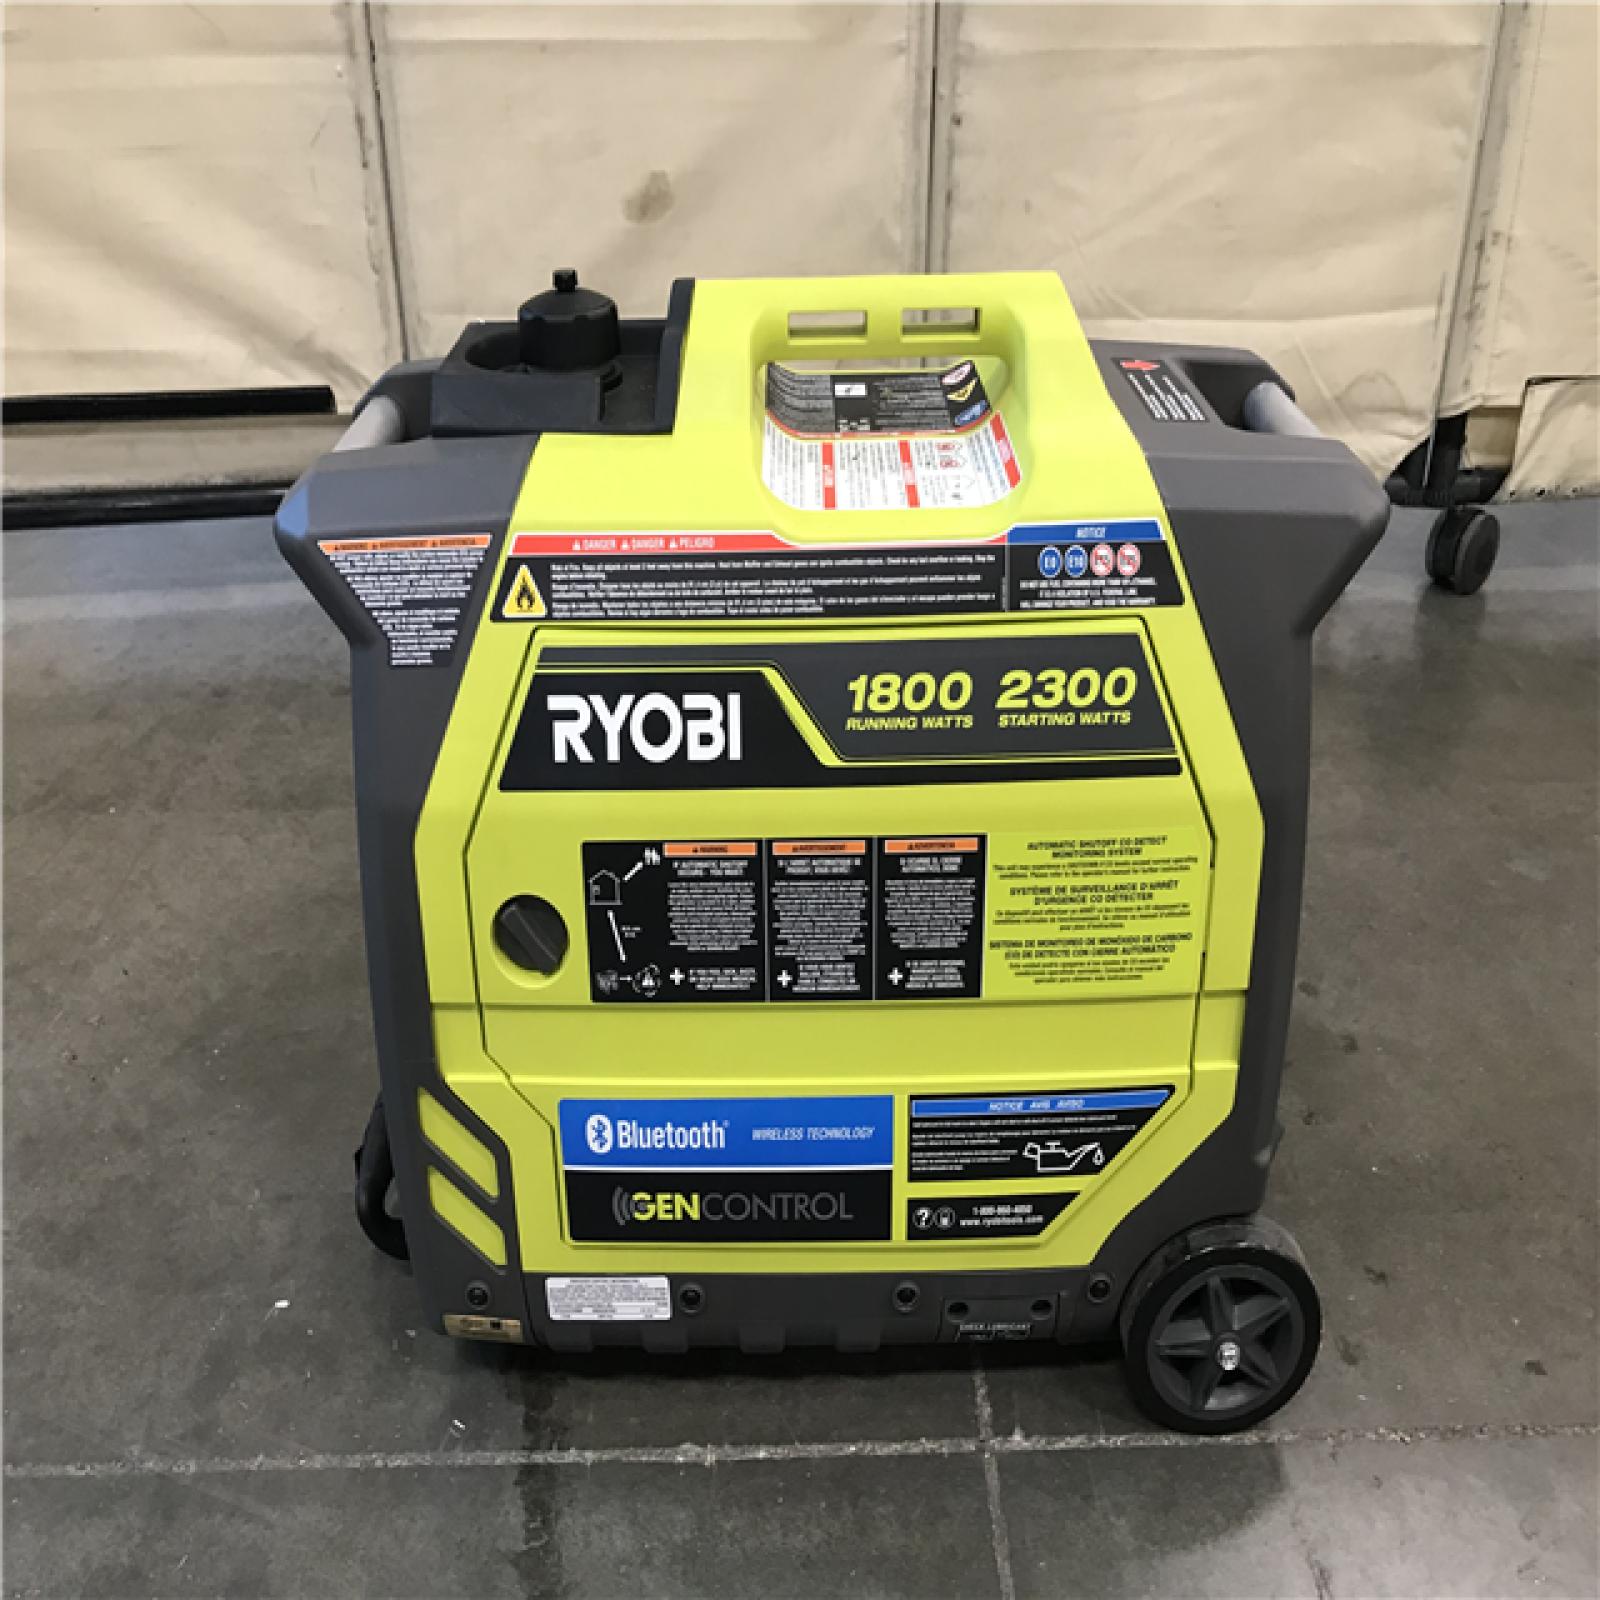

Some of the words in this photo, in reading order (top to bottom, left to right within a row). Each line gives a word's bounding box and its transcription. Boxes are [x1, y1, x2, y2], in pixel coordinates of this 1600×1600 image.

[847, 671, 974, 713] 1800
[994, 667, 1138, 709] 2300
[546, 692, 743, 764] RYOBI
[845, 715, 918, 732] RUNNING
[921, 714, 974, 730] WATTS
[998, 712, 1076, 729] STARTING
[1080, 710, 1132, 727] WATTS
[1027, 840, 1075, 850] AUTOMATIC
[617, 1119, 727, 1149] Bluetooth
[752, 1127, 803, 1141] WIRELESS
[807, 1125, 876, 1141] TECHNOLOGY
